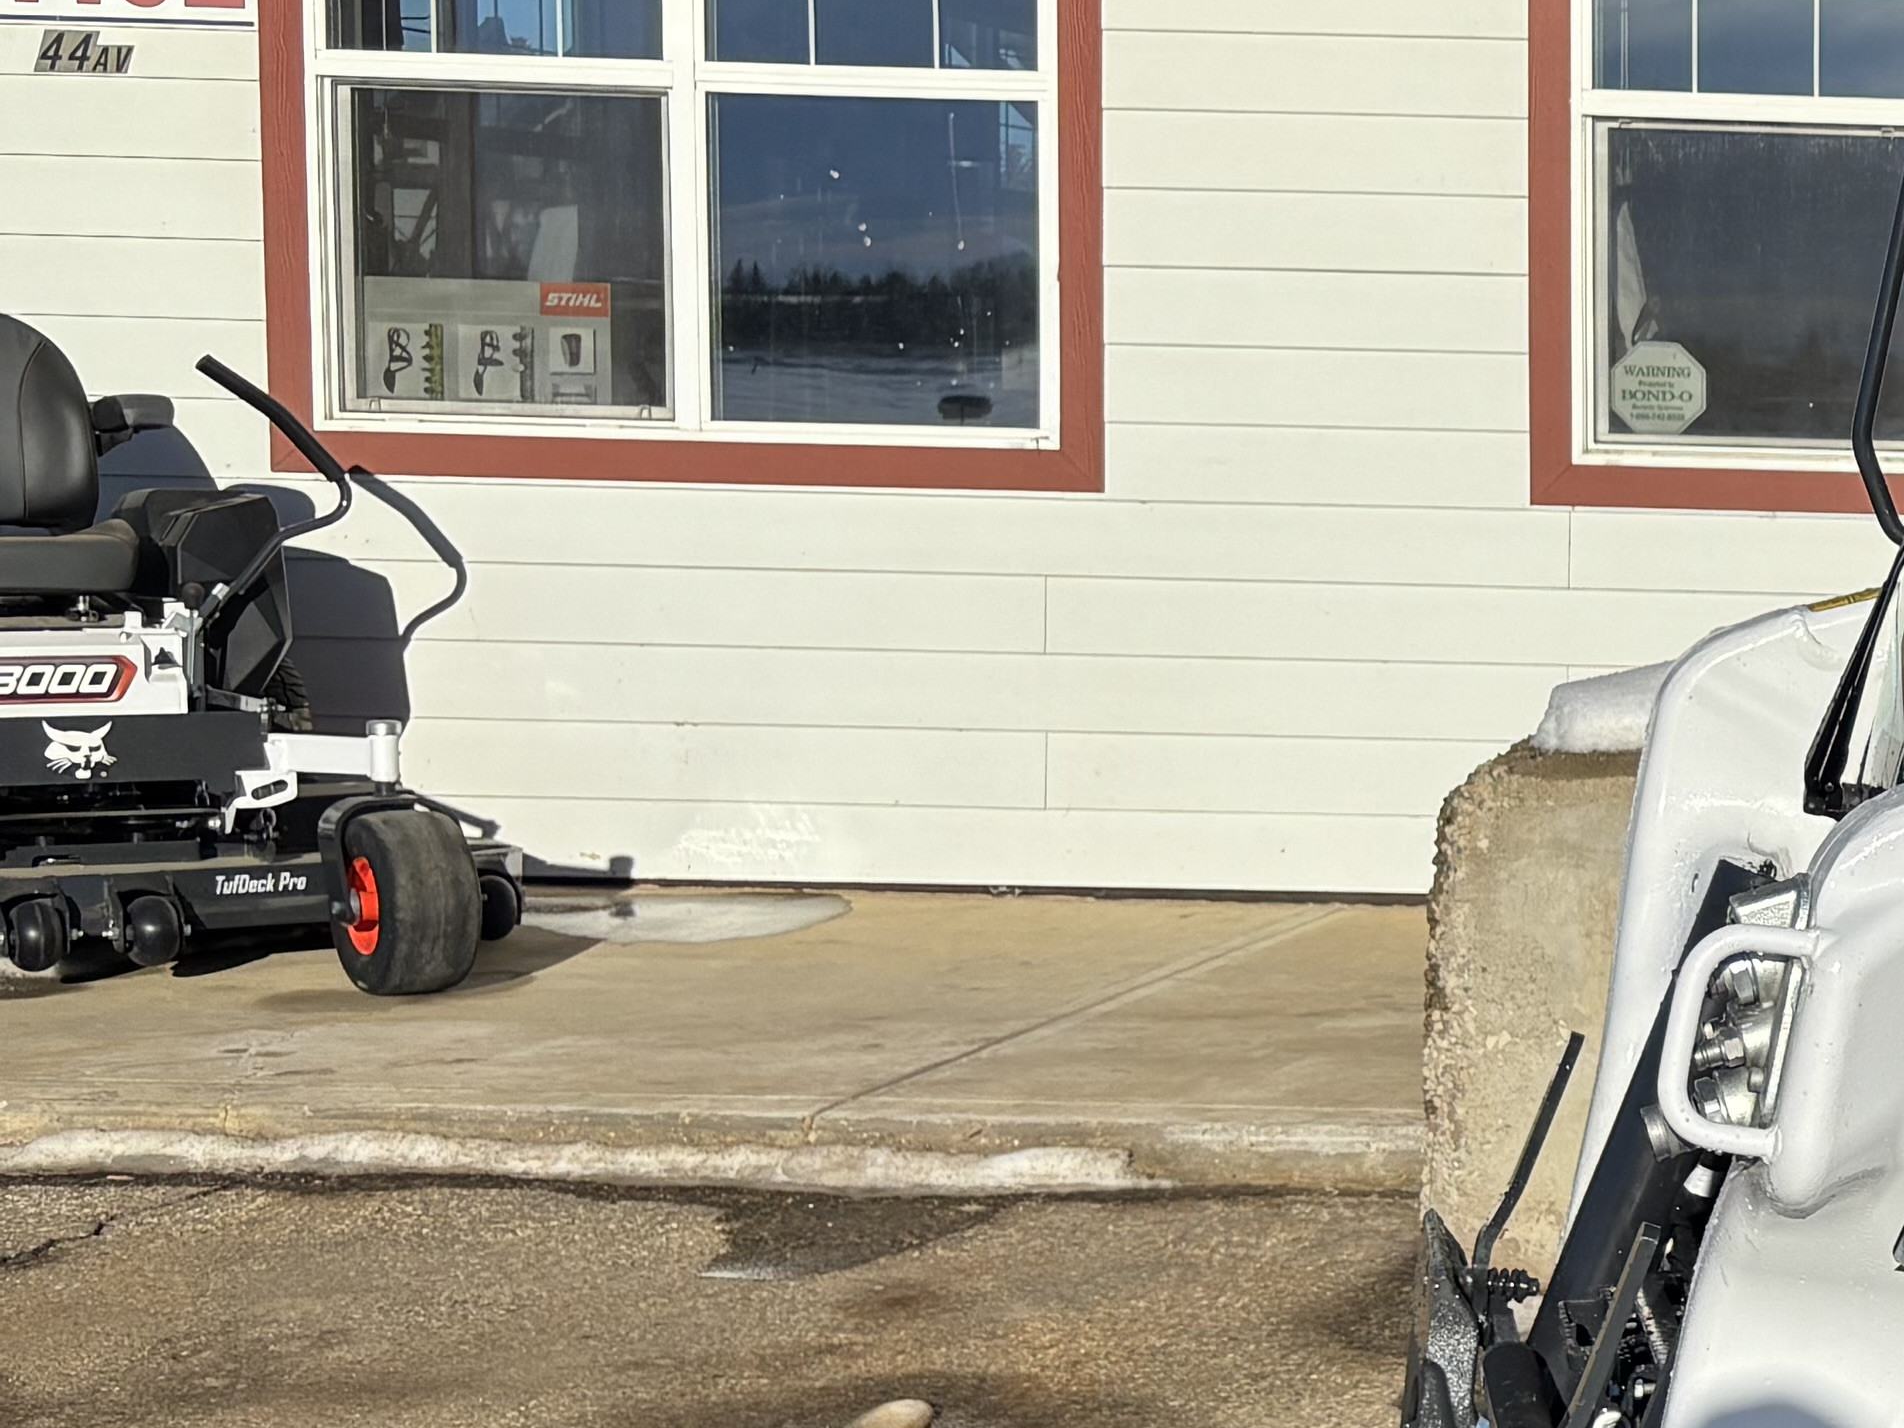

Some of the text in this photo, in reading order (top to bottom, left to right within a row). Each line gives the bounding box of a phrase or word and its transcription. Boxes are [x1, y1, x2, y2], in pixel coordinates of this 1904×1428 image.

[546, 293, 602, 307] STIHL
[1623, 365, 1691, 378] WARNING
[215, 871, 307, 895] TufDeck Pro
